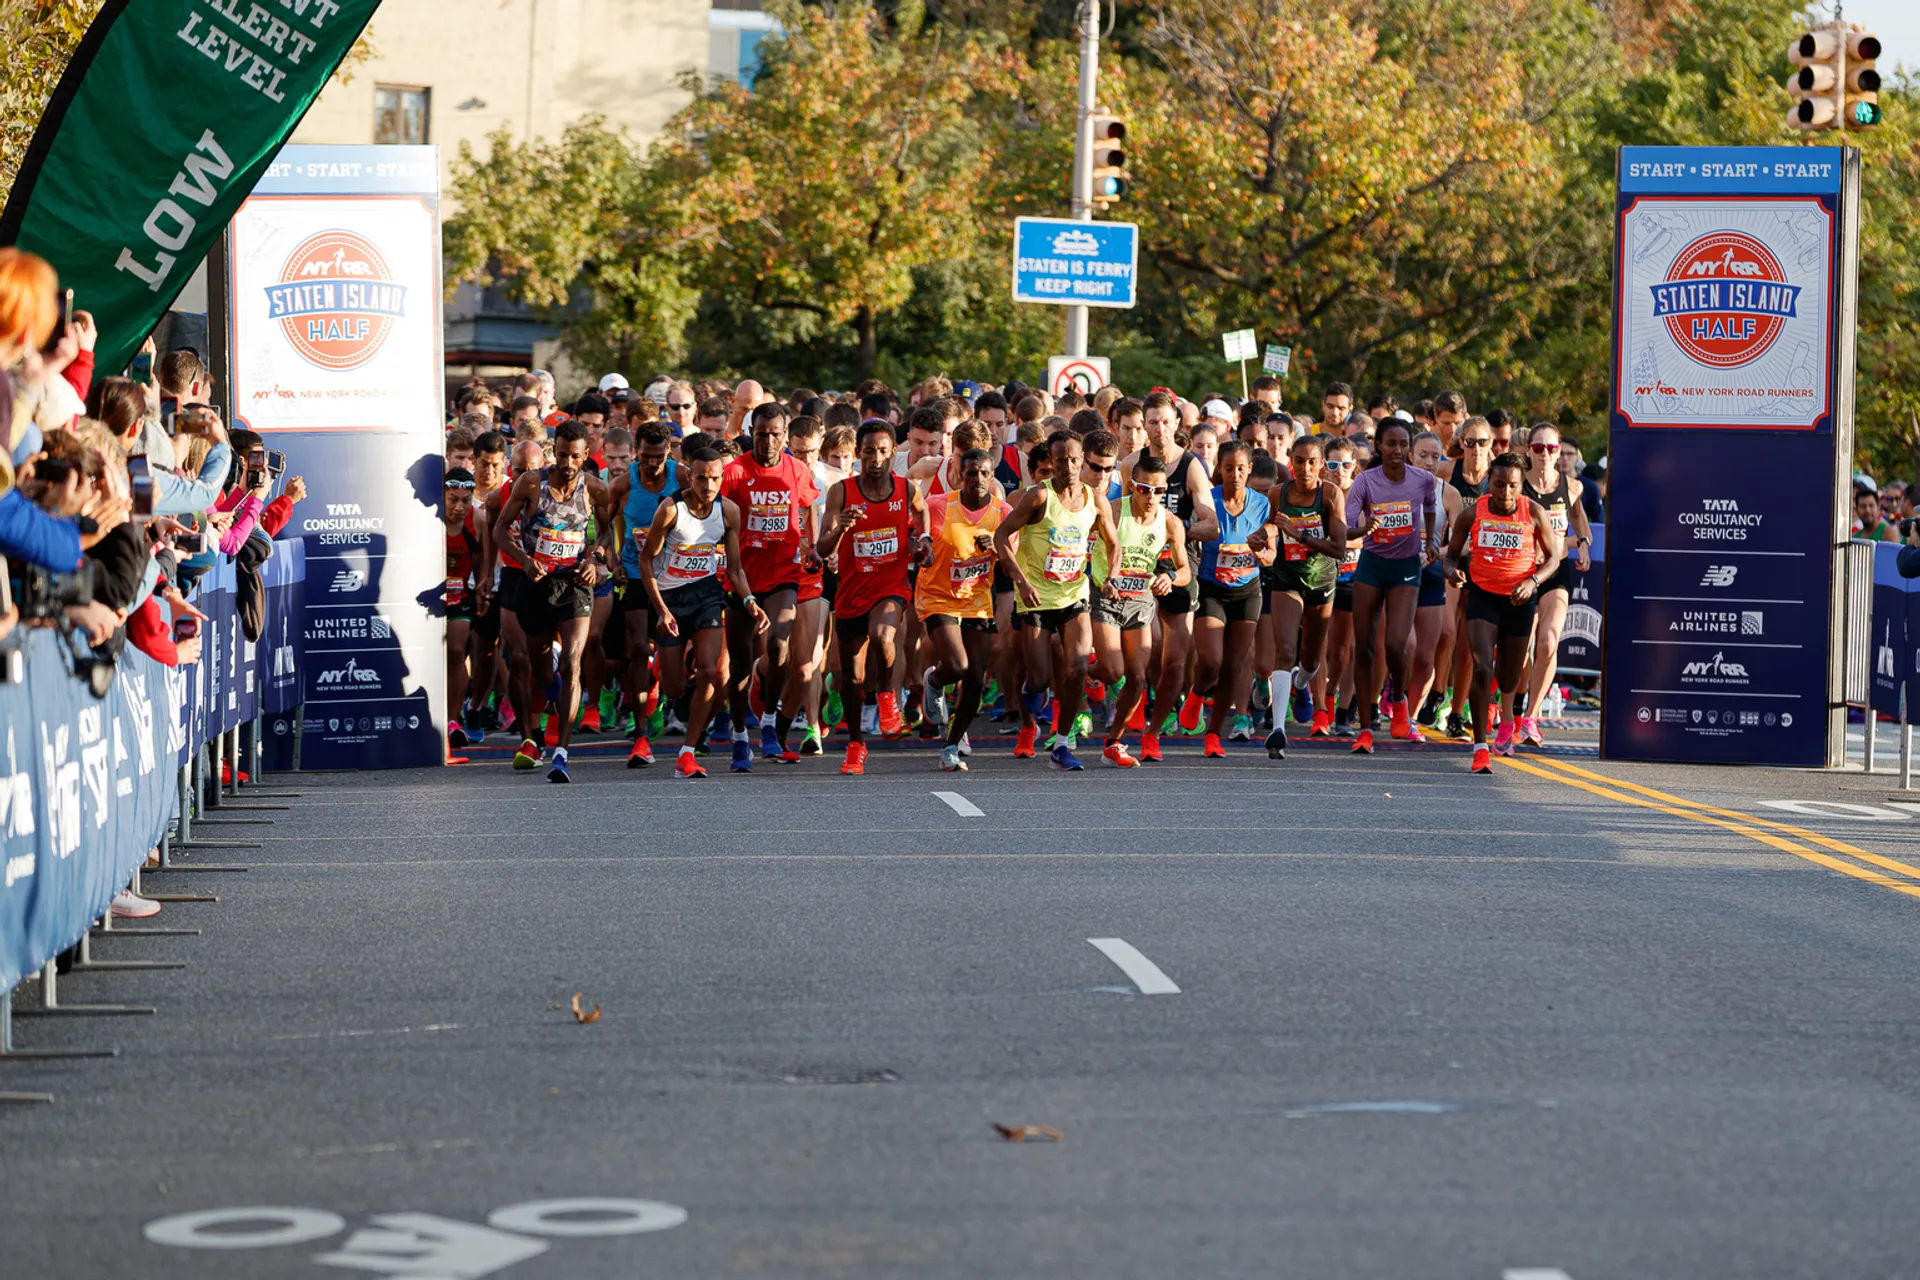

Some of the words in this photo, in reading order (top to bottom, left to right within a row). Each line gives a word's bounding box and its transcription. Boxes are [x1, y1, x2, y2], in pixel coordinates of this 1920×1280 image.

[176, 11, 287, 104] LEVEL
[307, 163, 362, 177] START
[1629, 163, 1686, 178] START
[1701, 163, 1758, 178] START
[1774, 164, 1832, 178] START
[114, 127, 235, 293] LOW
[1018, 257, 1069, 274] STATEN
[1070, 260, 1084, 275] IS
[1086, 261, 1132, 278] FERRY
[1034, 278, 1072, 294] KEEP
[1073, 280, 1114, 296] RIGHT
[271, 283, 335, 315] STATEN
[341, 283, 403, 314] ISLAND
[1657, 283, 1720, 313] STATEN
[1728, 283, 1794, 313] ISLAND
[307, 318, 370, 341] HALF
[1691, 317, 1757, 340] HALF
[1682, 388, 1705, 396] NEW
[1708, 388, 1734, 396] YORK
[1737, 388, 1764, 396] ROAD
[1768, 389, 1814, 398] RUNNERS
[749, 491, 792, 505] WSX
[326, 504, 362, 516] TATA
[1702, 499, 1739, 511] TATA
[303, 518, 384, 531] CONSULTANCY
[761, 518, 786, 531] 2988
[1383, 514, 1409, 528] 2996
[1678, 512, 1763, 526] CONSULTANCY
[319, 532, 372, 544] SERVICES
[1693, 527, 1748, 540] SERVICES
[1492, 534, 1518, 548] 2968
[550, 543, 574, 556] 2970
[870, 540, 893, 556] 2977
[684, 557, 708, 570] 2972
[954, 568, 960, 578] A
[1121, 578, 1144, 590] 5793
[314, 618, 368, 628] UNITED
[1683, 611, 1738, 622] UNITED
[304, 628, 368, 639] AIRLINES
[1669, 622, 1738, 632] AIRLINES
